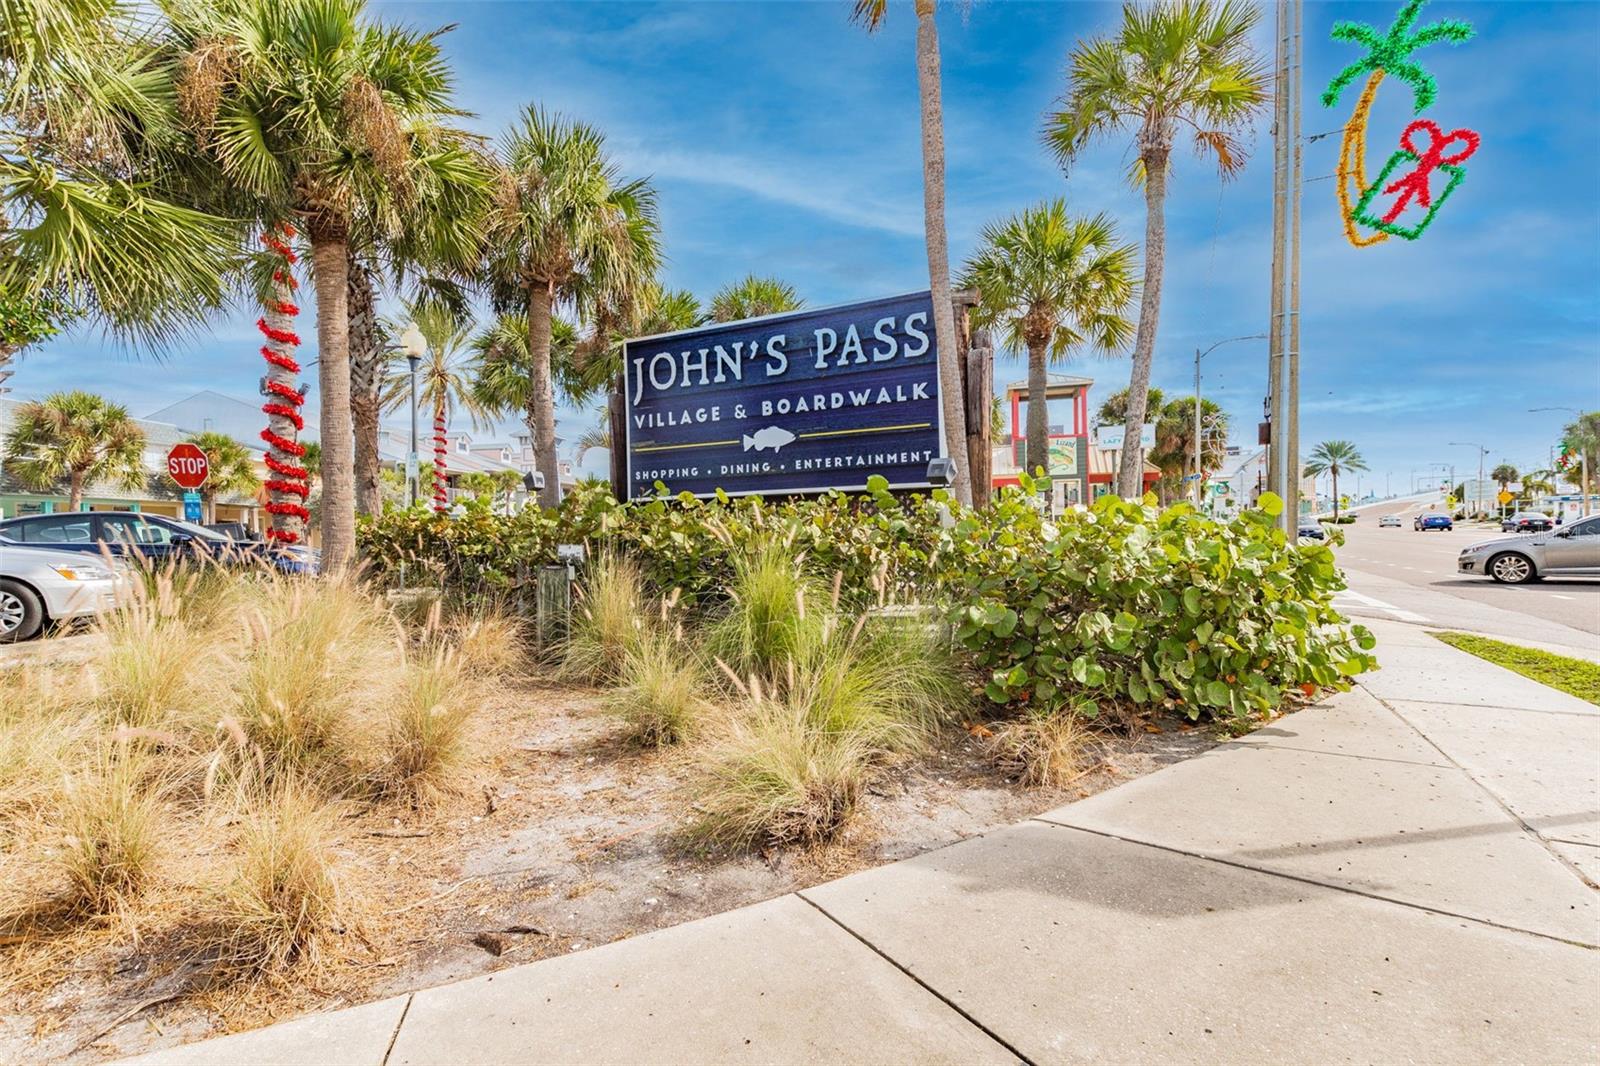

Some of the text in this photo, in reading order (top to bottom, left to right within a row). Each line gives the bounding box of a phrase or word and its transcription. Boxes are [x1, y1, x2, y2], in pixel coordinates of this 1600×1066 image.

[814, 312, 931, 370] PASS
[634, 382, 930, 430] VILLAGE & BOARDWALK
[169, 458, 205, 475] STOP
[635, 451, 932, 480] SHOPPING DINING ENTERTAINMENT
